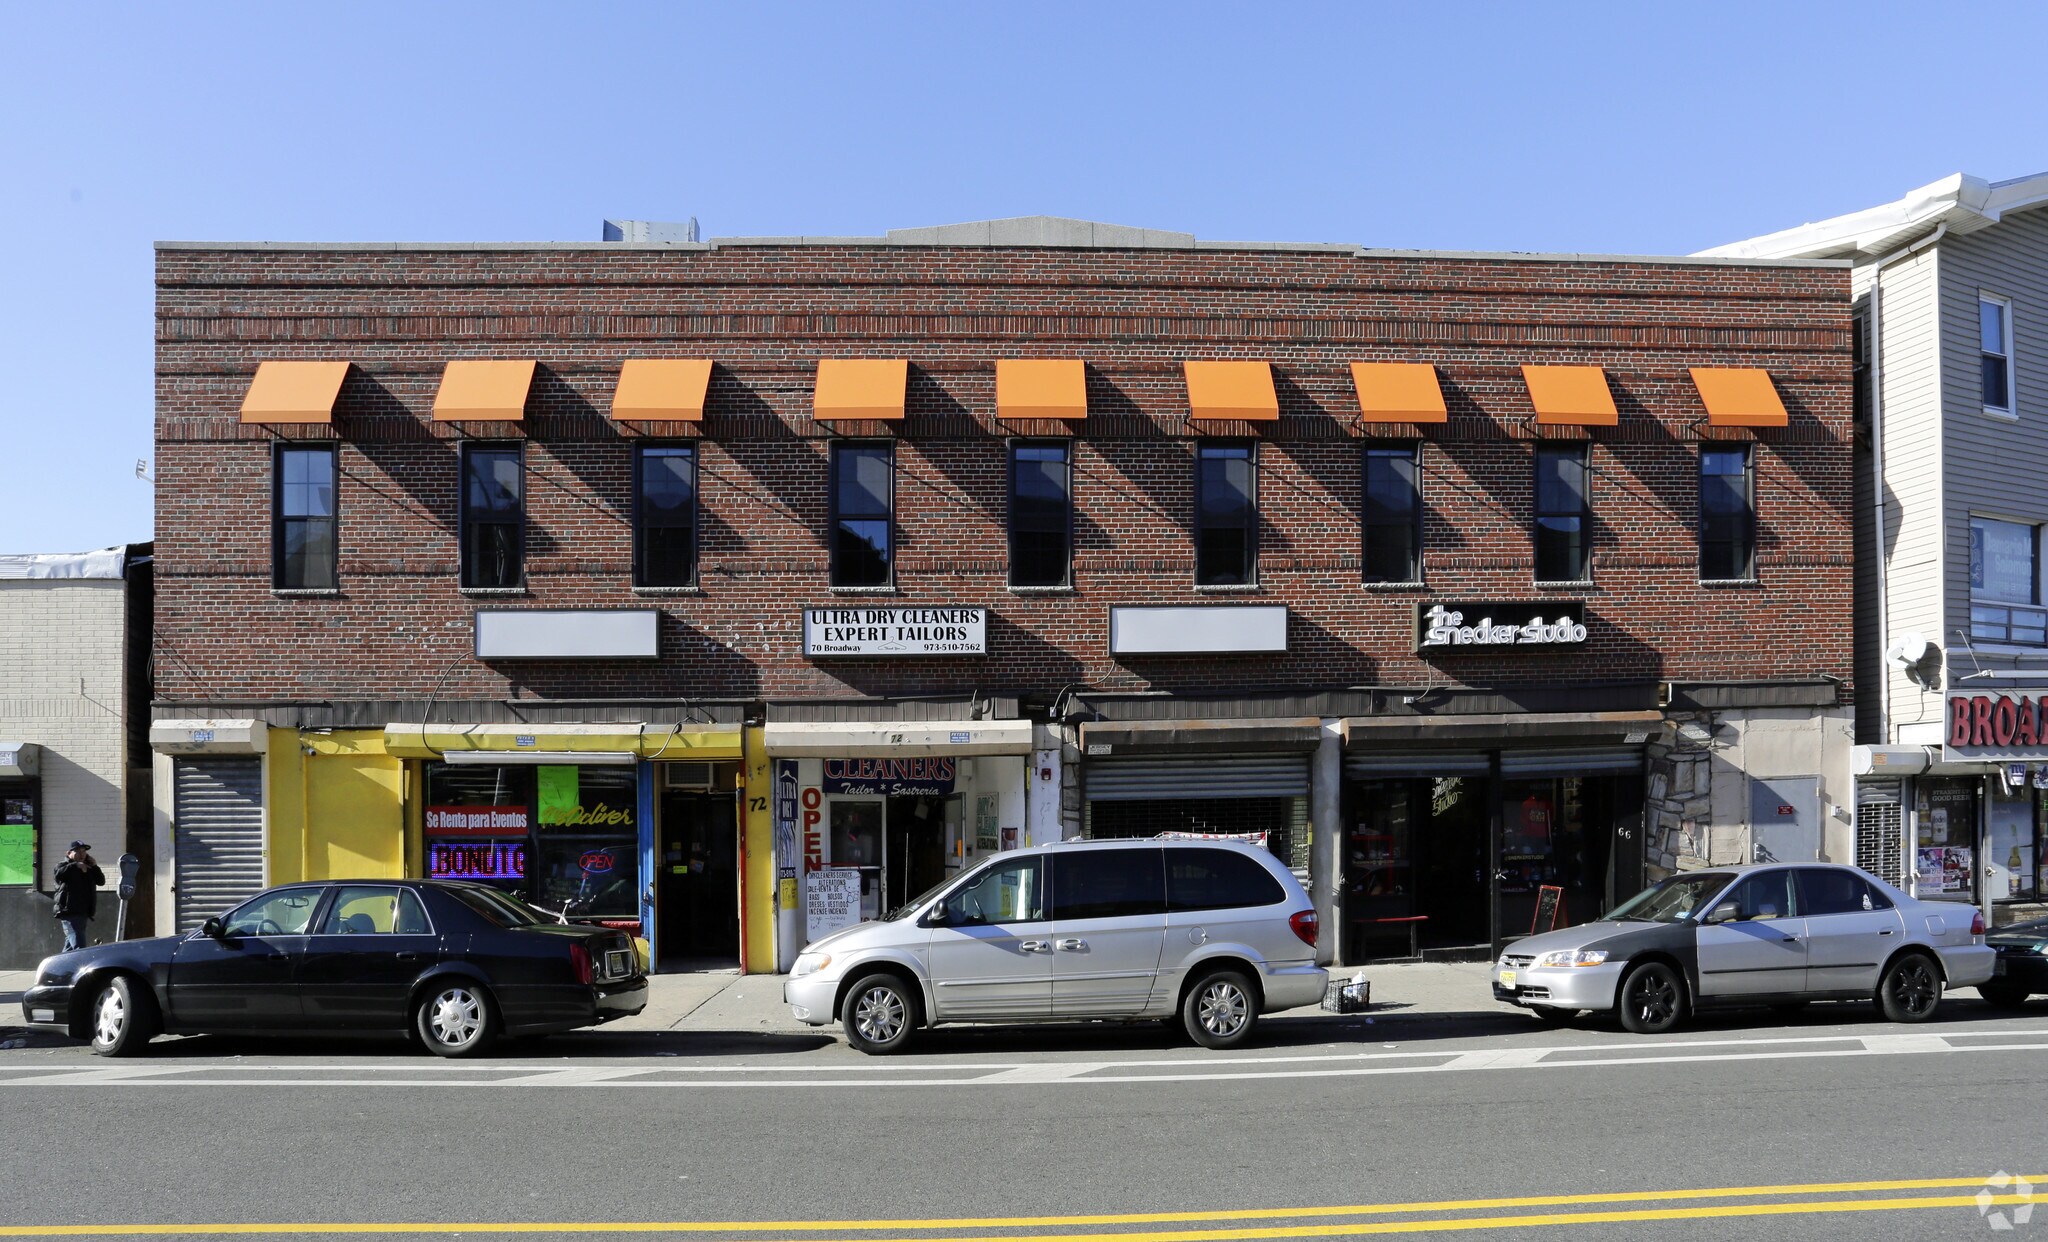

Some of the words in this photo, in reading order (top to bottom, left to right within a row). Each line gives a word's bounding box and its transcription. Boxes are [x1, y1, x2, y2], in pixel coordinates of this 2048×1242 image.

[812, 611, 860, 624] ULTRA
[866, 611, 897, 624] DRY
[902, 610, 979, 624] CLEANERS
[1424, 605, 1463, 626] the
[825, 628, 889, 641] EXPERT
[896, 627, 967, 640] TAILORS
[825, 644, 861, 652] Broadway
[891, 734, 903, 743] 72
[824, 757, 955, 780] CLEANERS
[841, 783, 875, 795] Tailor
[891, 783, 940, 795] Sastreria
[750, 796, 767, 812] 72
[427, 811, 438, 828] Se
[440, 811, 467, 828] Renta
[468, 813, 490, 829] para
[491, 811, 527, 828] Eventos
[564, 803, 634, 827] Deliver
[802, 788, 821, 876] OPEN
[1618, 827, 1631, 839] 66
[579, 855, 614, 868] OPEN
